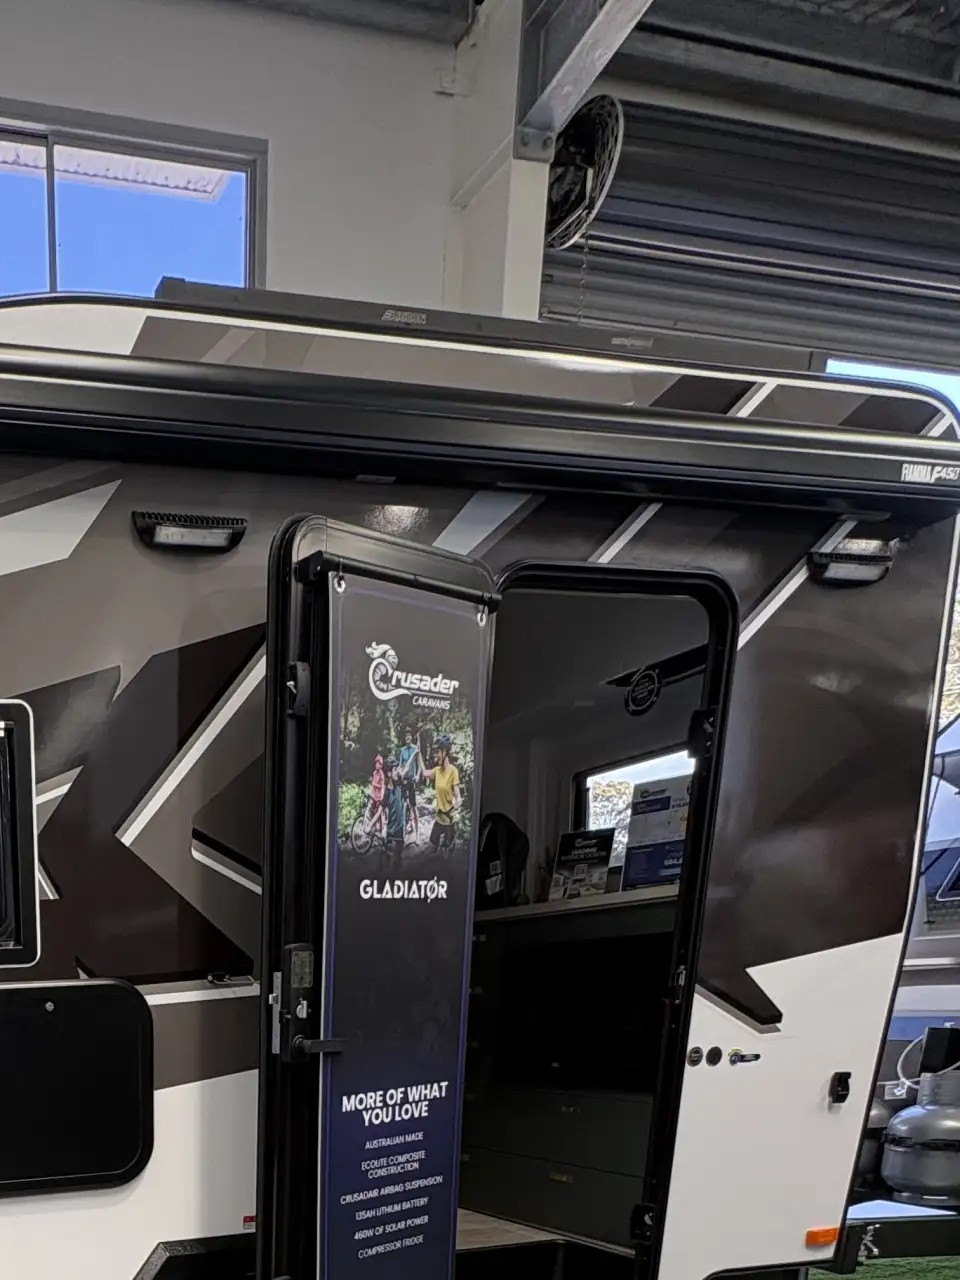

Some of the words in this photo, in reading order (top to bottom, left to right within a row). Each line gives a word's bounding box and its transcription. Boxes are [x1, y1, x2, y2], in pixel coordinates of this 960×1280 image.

[368, 657, 460, 700] Crusader
[412, 696, 451, 710] CARAVANS
[342, 1090, 384, 1112] MORE
[386, 1087, 405, 1105] OF
[407, 1081, 449, 1102] WHAT
[362, 1106, 392, 1126] YOU
[395, 1101, 429, 1121] LOVE
[365, 1135, 404, 1150] AUSTRALIAN
[405, 1131, 424, 1142] MADE
[388, 1150, 426, 1165] COMPOSITE
[367, 1161, 420, 1179] CONSTRUCTION
[340, 1188, 379, 1204] CRUSADAIR
[380, 1183, 404, 1196] AIRBAG
[404, 1175, 443, 1191] SUSPENSION
[376, 1203, 401, 1216] LITHIUM
[402, 1197, 429, 1210] BATTERY
[374, 1225, 384, 1236] OF
[385, 1221, 405, 1233] SOLAR
[406, 1215, 429, 1228] POWER
[358, 1240, 401, 1259] COMPRESSOR
[402, 1234, 424, 1248] FRIDGE
